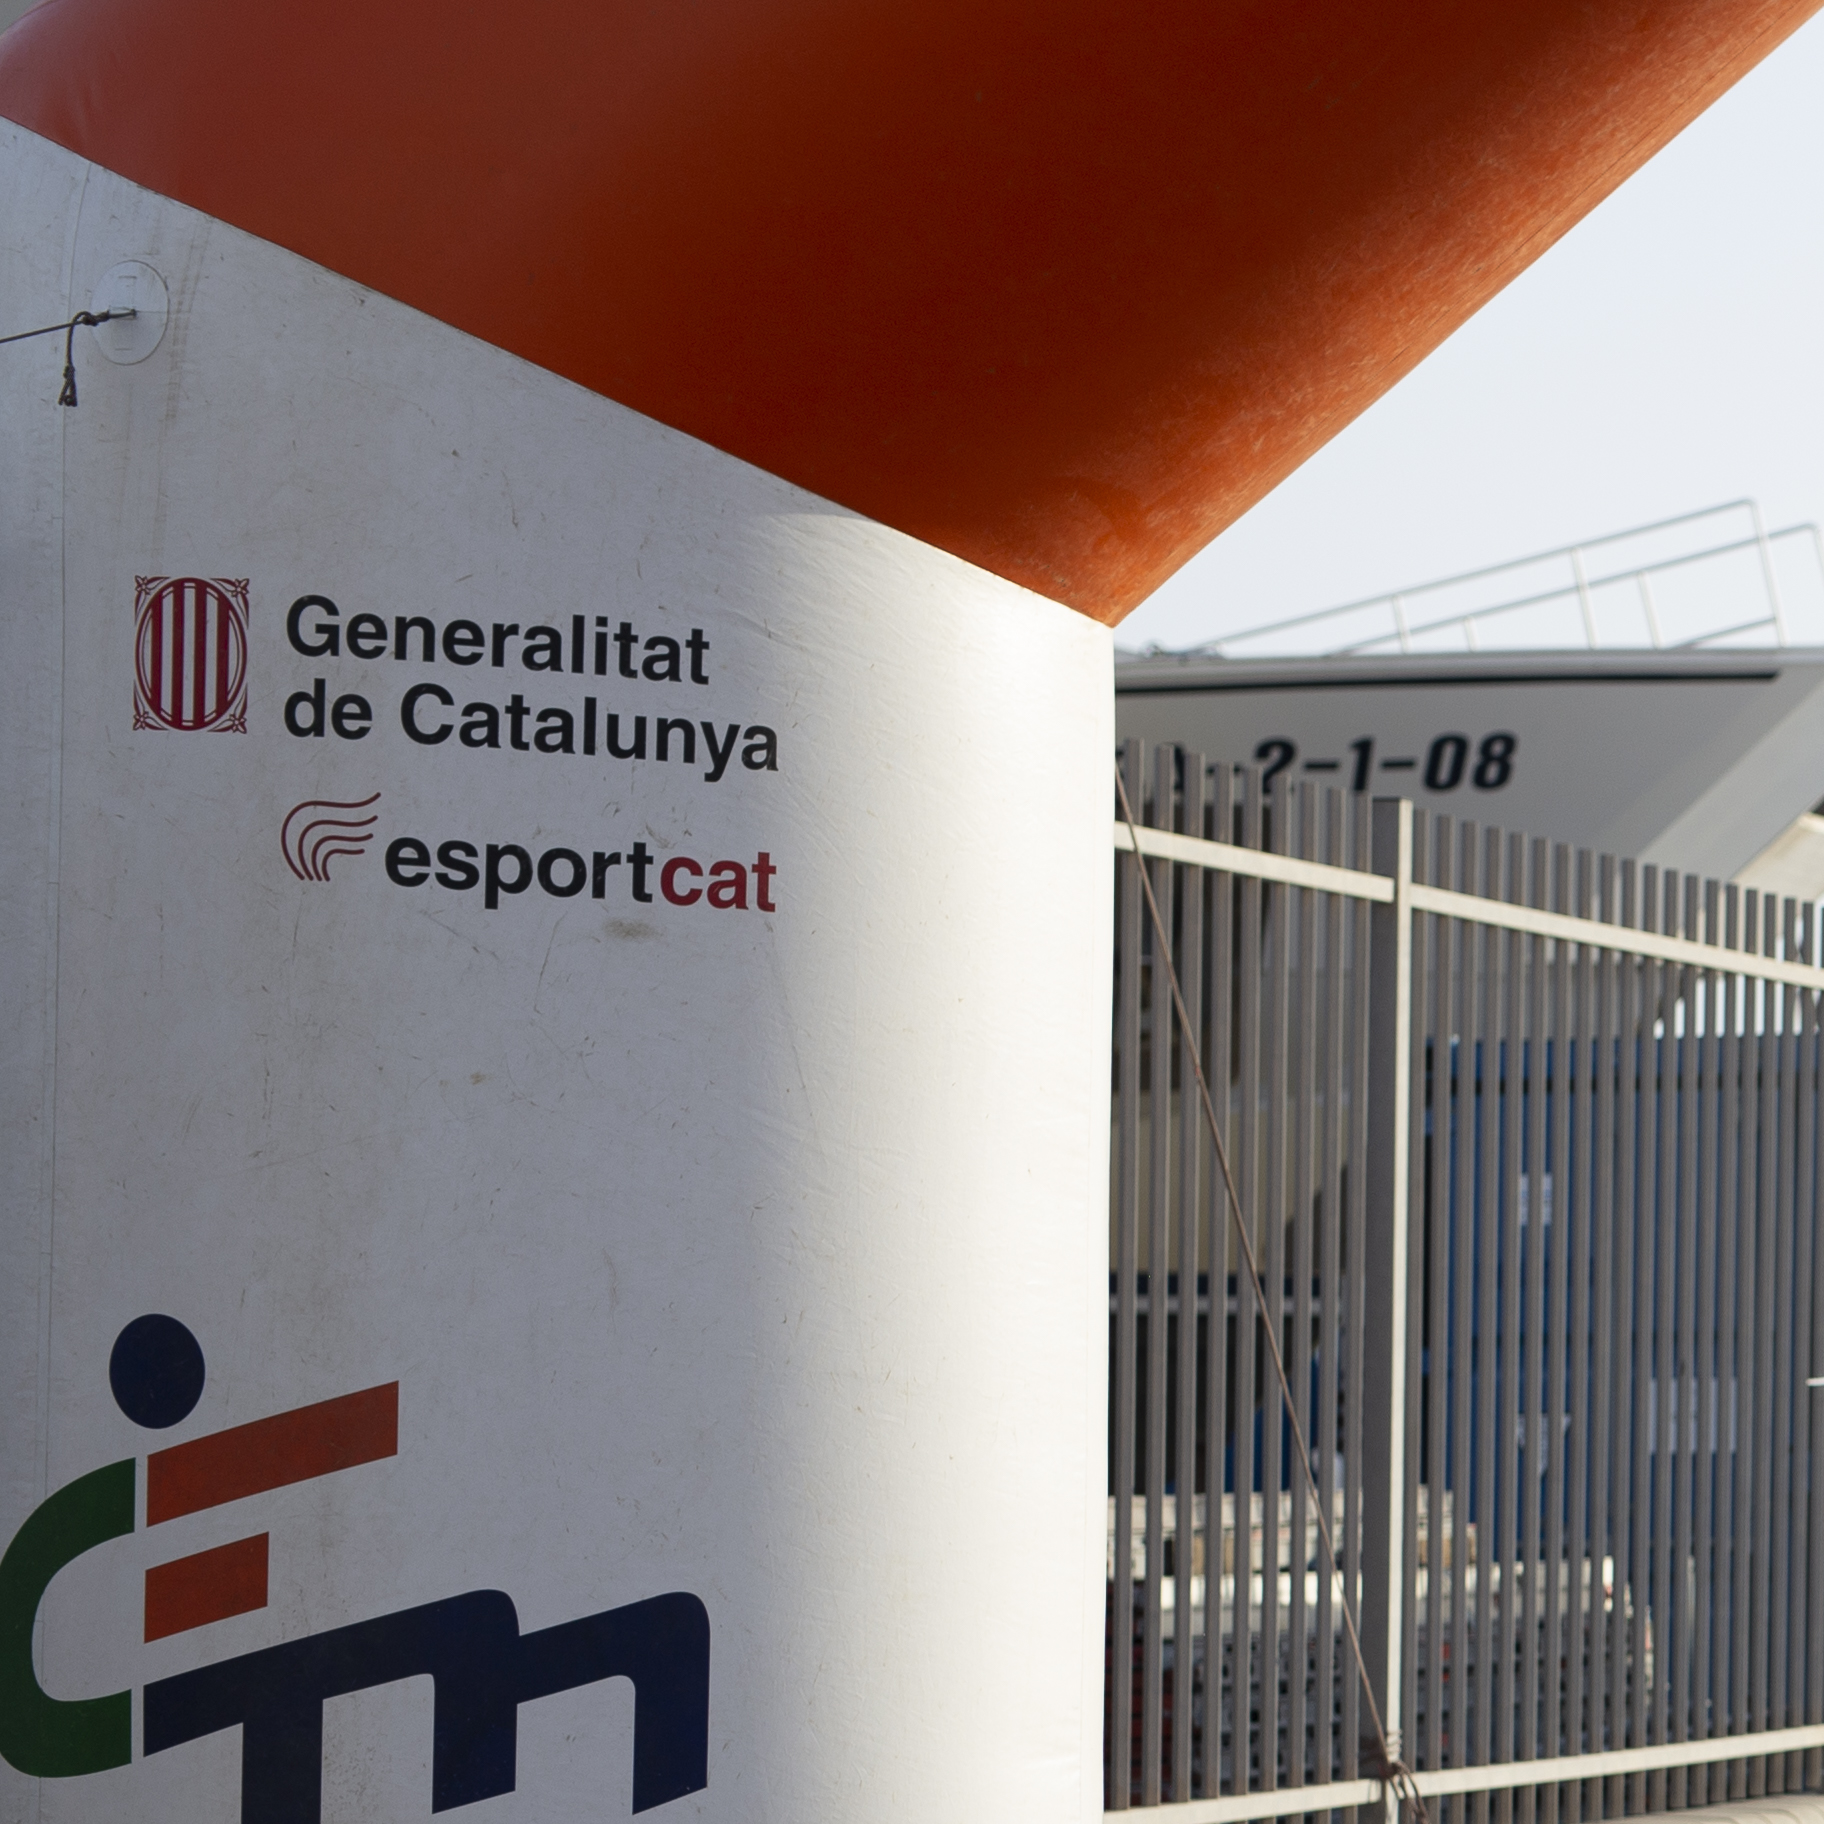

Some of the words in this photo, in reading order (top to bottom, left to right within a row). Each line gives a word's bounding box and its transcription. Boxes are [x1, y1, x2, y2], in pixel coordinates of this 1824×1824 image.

[286, 594, 710, 686] Generalitat
[283, 679, 373, 741] de
[399, 682, 779, 782] Catalunya
[384, 831, 777, 913] esportcat
